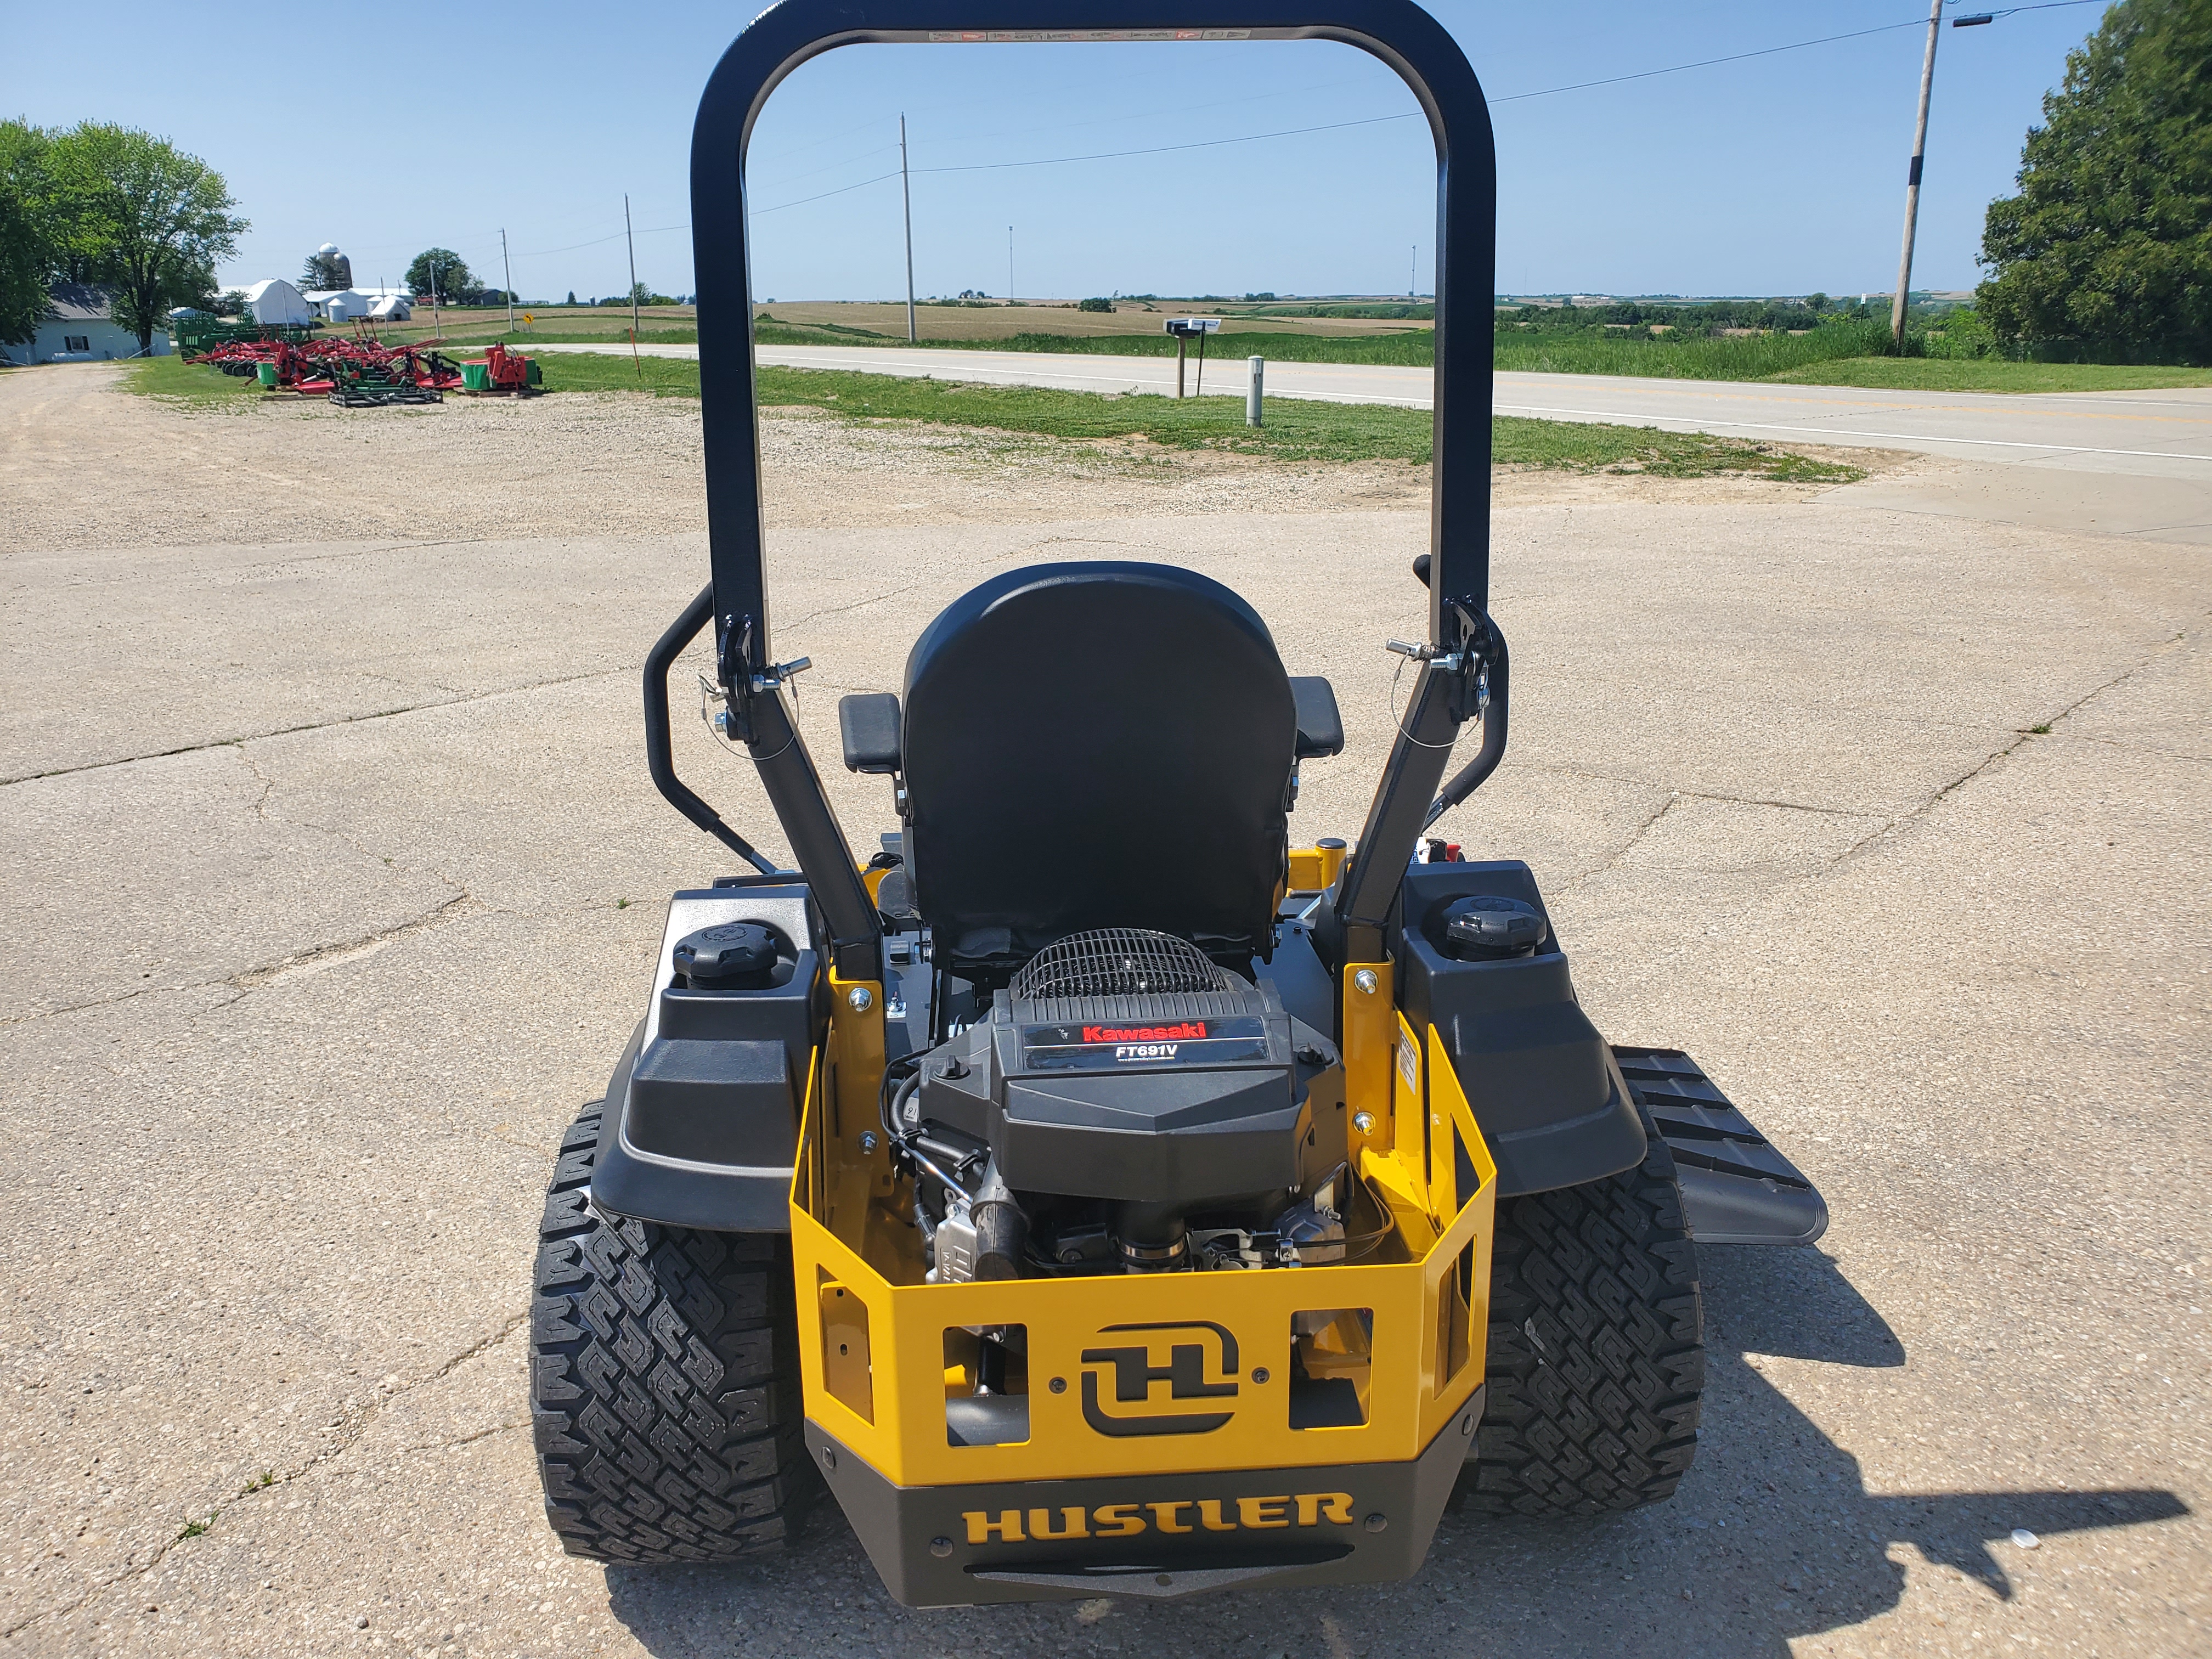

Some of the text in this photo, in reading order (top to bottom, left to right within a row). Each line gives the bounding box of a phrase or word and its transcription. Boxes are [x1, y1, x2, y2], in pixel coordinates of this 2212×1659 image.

[1082, 1023, 1206, 1042] Kawasaki
[1115, 1044, 1178, 1057] FT691V
[962, 1491, 1355, 1545] HUSTLER
